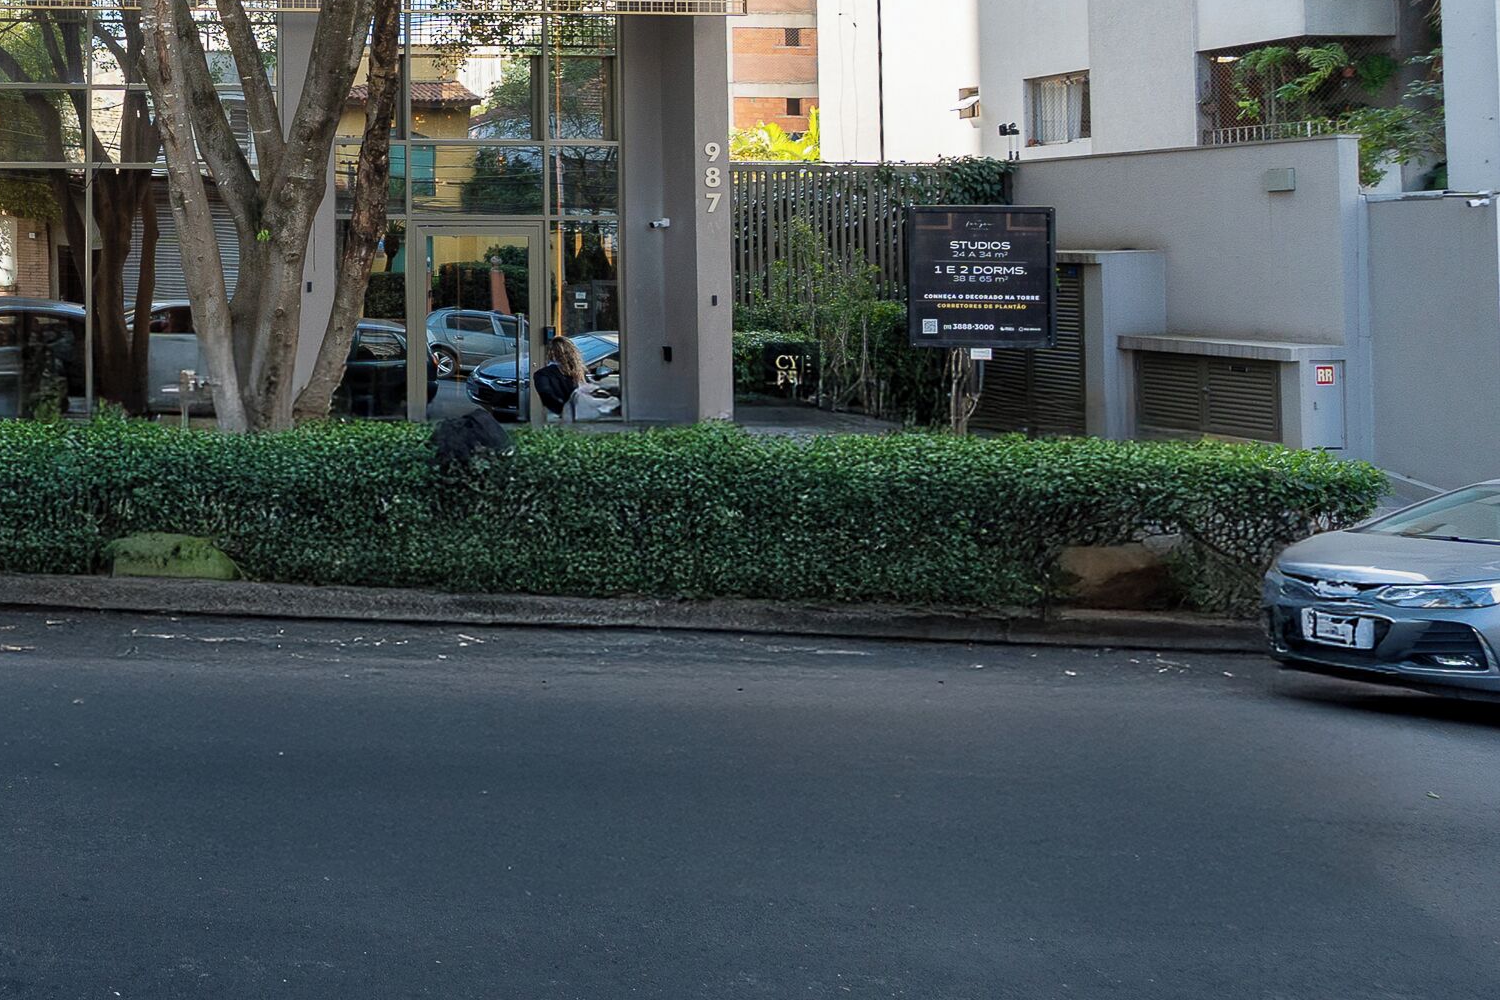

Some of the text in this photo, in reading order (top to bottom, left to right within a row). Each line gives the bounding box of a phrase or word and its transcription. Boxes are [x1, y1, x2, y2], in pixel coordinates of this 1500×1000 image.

[704, 142, 721, 213] 987
[949, 240, 1011, 250] STUDIOS
[934, 265, 1028, 275] 1 E 2 DORMS.
[995, 302, 1026, 310] PLANTÃO
[1317, 369, 1332, 382] RR
